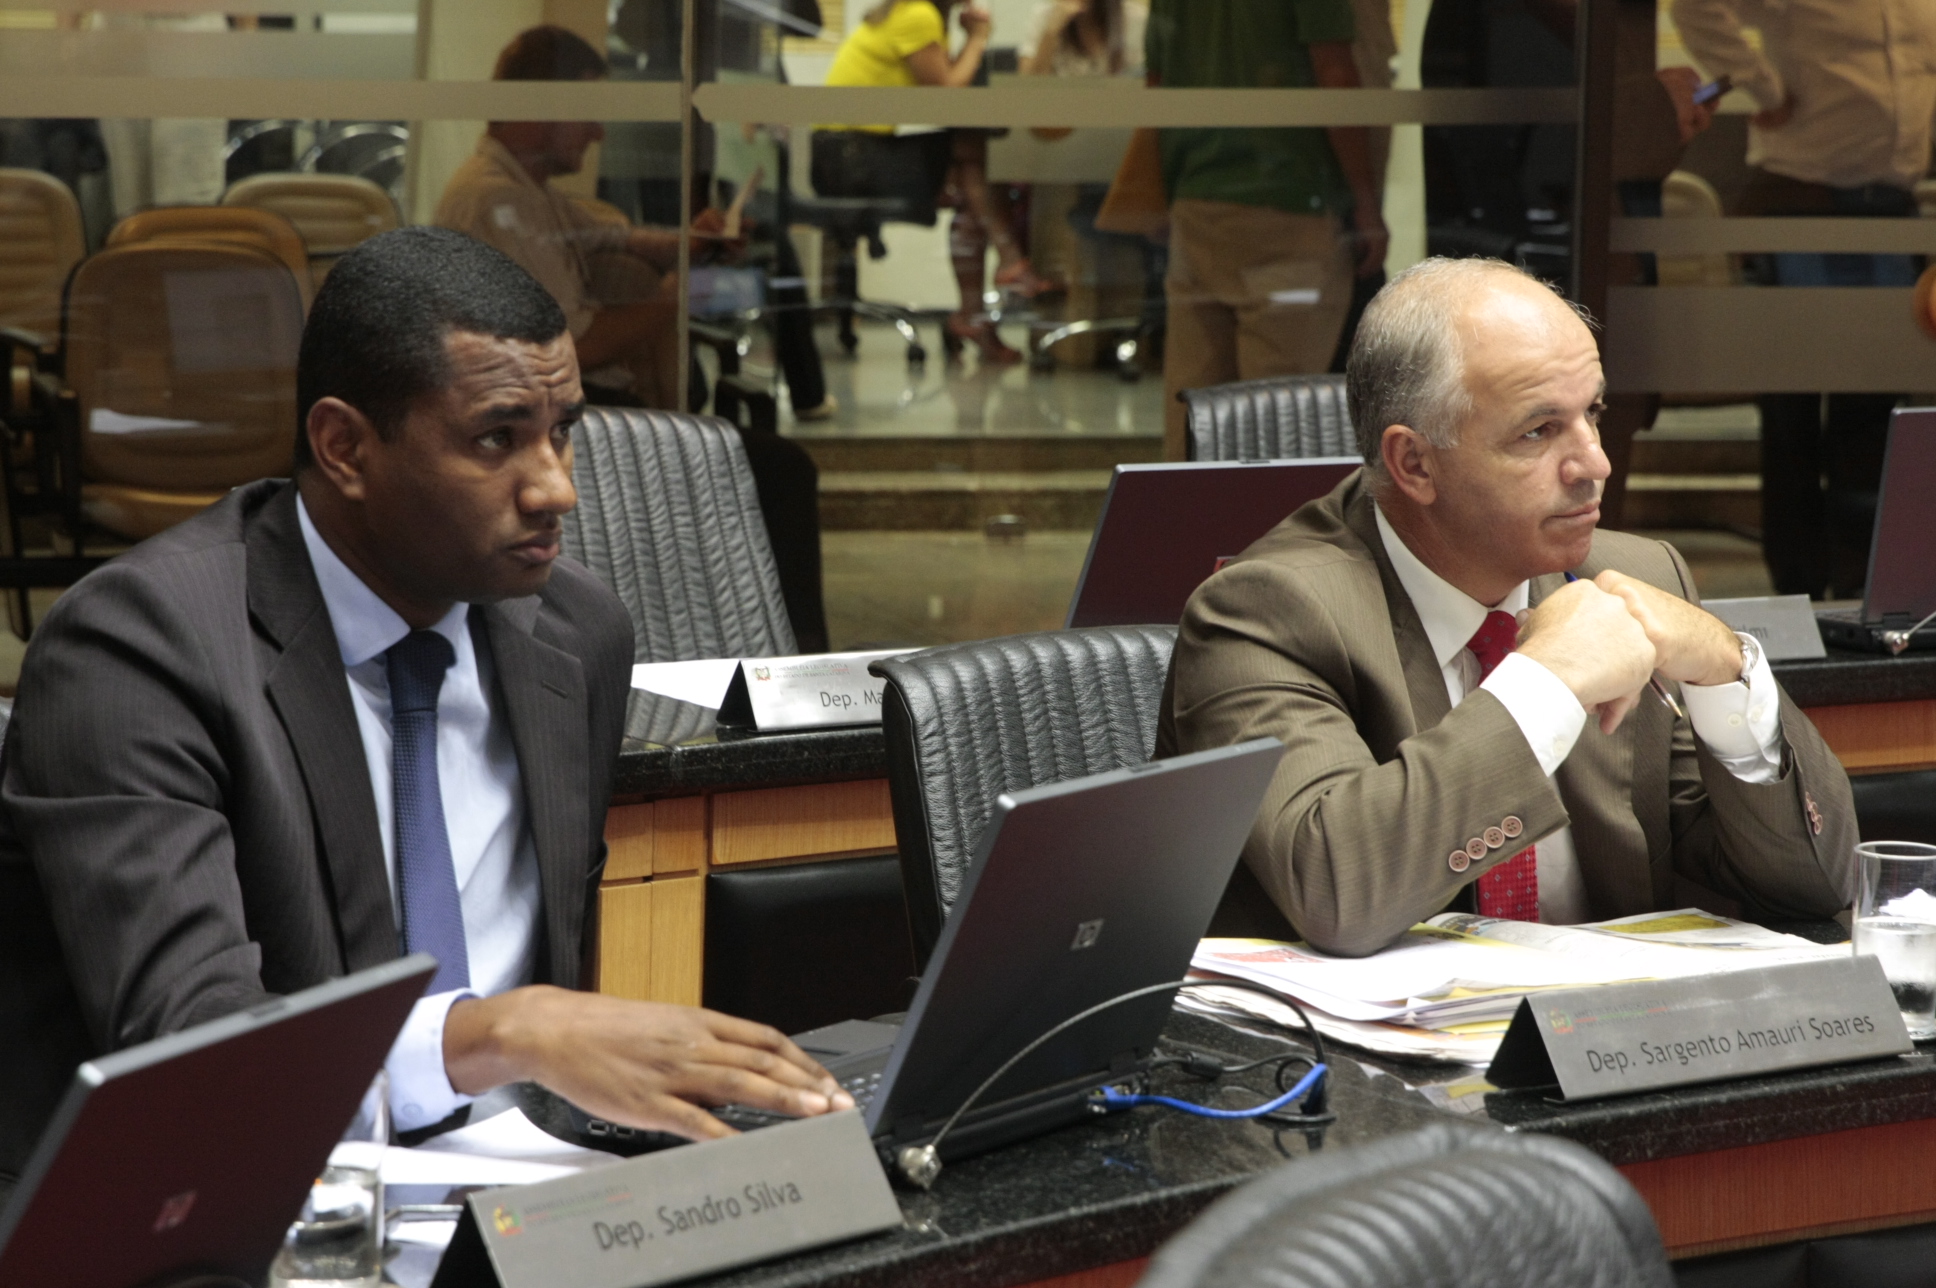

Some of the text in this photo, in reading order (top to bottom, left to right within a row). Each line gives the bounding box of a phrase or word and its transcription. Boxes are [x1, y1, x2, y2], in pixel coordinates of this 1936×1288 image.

[819, 692, 857, 709] Dep.
[1586, 1014, 1875, 1074] Dep. Sargento Amauri Soares
[592, 1218, 655, 1251] Dep.
[658, 1195, 742, 1235] Sandro
[743, 1180, 803, 1213] Silva
